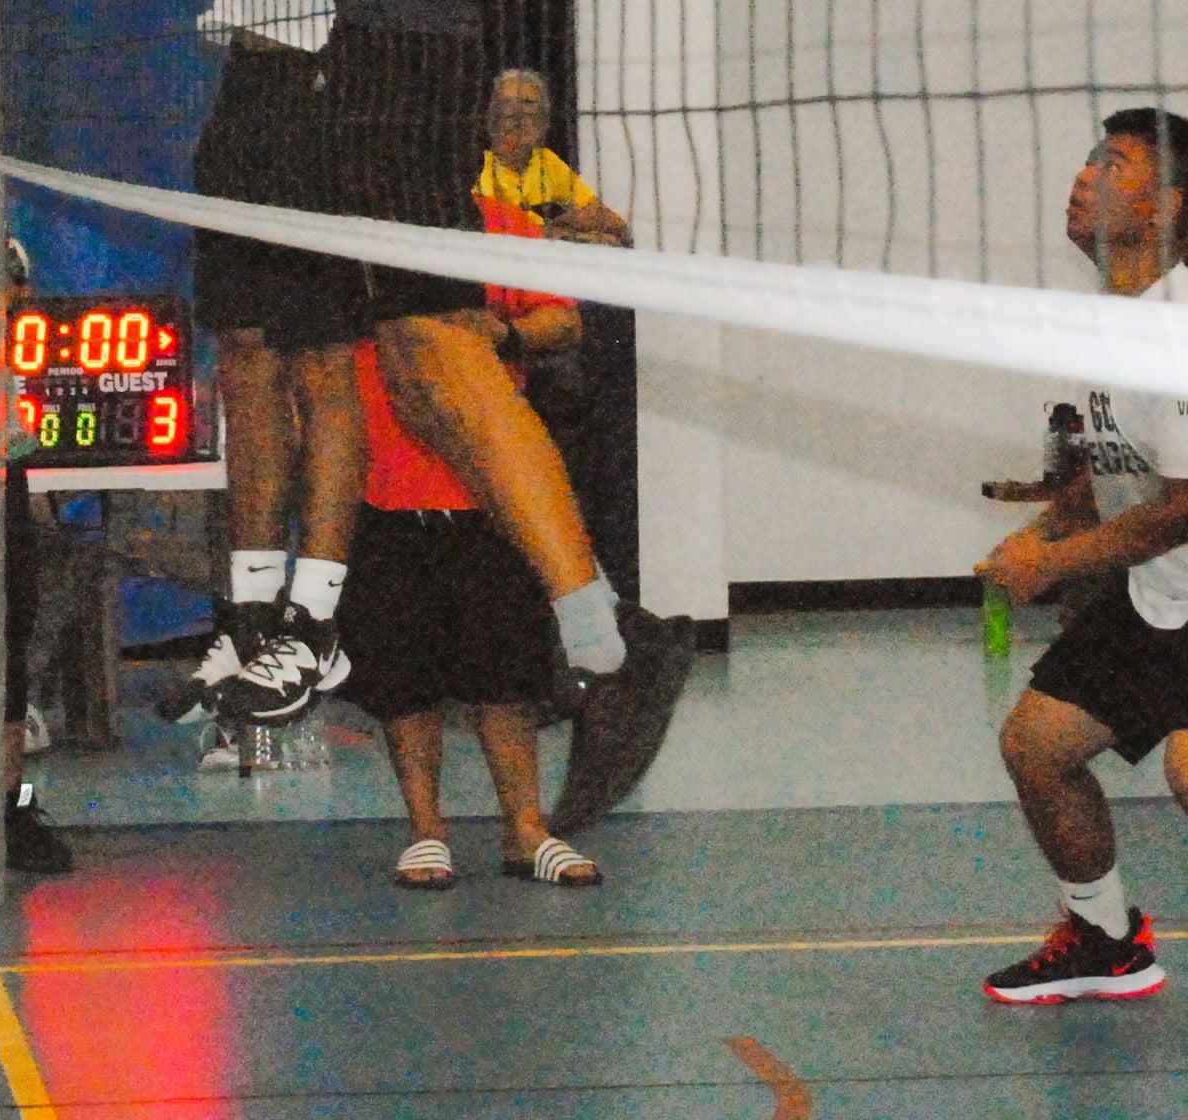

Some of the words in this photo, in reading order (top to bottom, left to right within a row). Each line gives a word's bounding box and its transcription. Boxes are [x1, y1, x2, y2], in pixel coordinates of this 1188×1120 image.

[14, 313, 150, 370] 0:00
[98, 371, 168, 393] GUEST
[151, 396, 178, 445] 3
